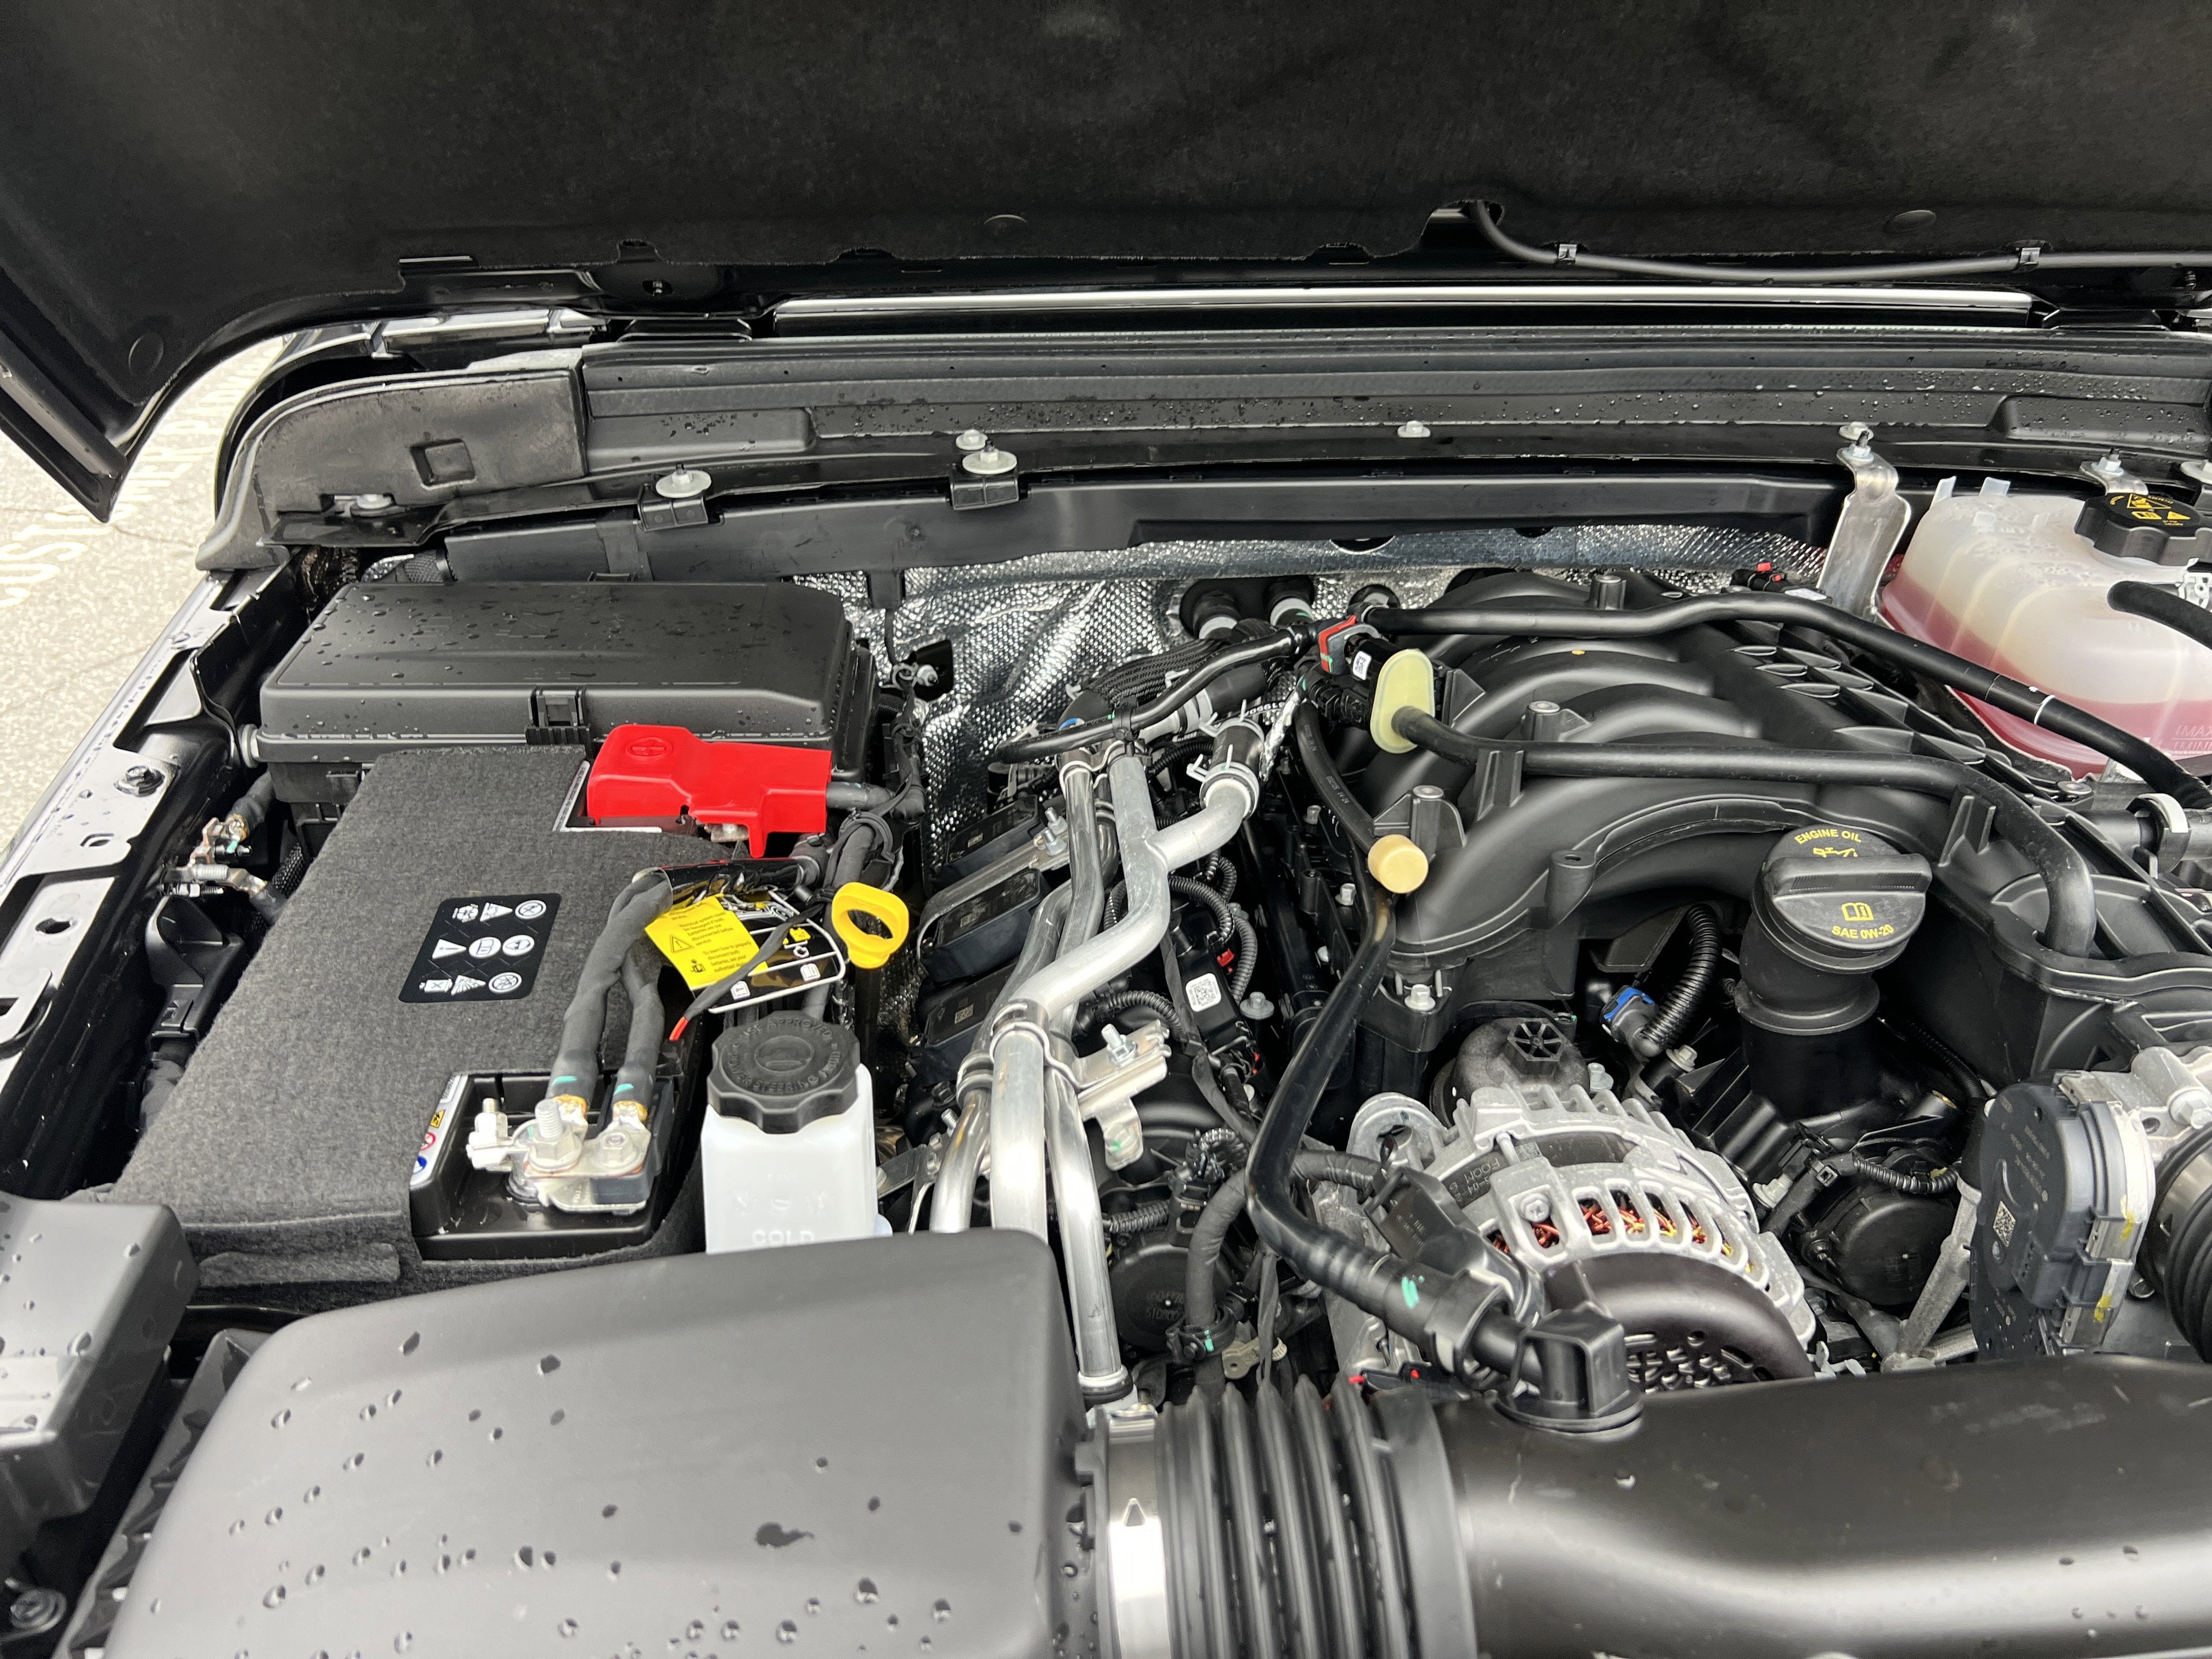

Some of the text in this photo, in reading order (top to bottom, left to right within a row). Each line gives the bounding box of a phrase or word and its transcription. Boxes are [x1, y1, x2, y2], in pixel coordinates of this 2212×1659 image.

[1795, 828, 1862, 845] ENGINE OIL
[699, 915, 714, 923] system
[691, 922, 709, 930] damaged
[687, 928, 707, 936] batteries
[692, 930, 720, 941] disconnected
[1832, 924, 1894, 940] SAE 0W-20
[708, 952, 729, 960] disconnect
[714, 964, 735, 973] authorized
[742, 1018, 833, 1041] USE APPROVED
[753, 1076, 819, 1093] STEERING
